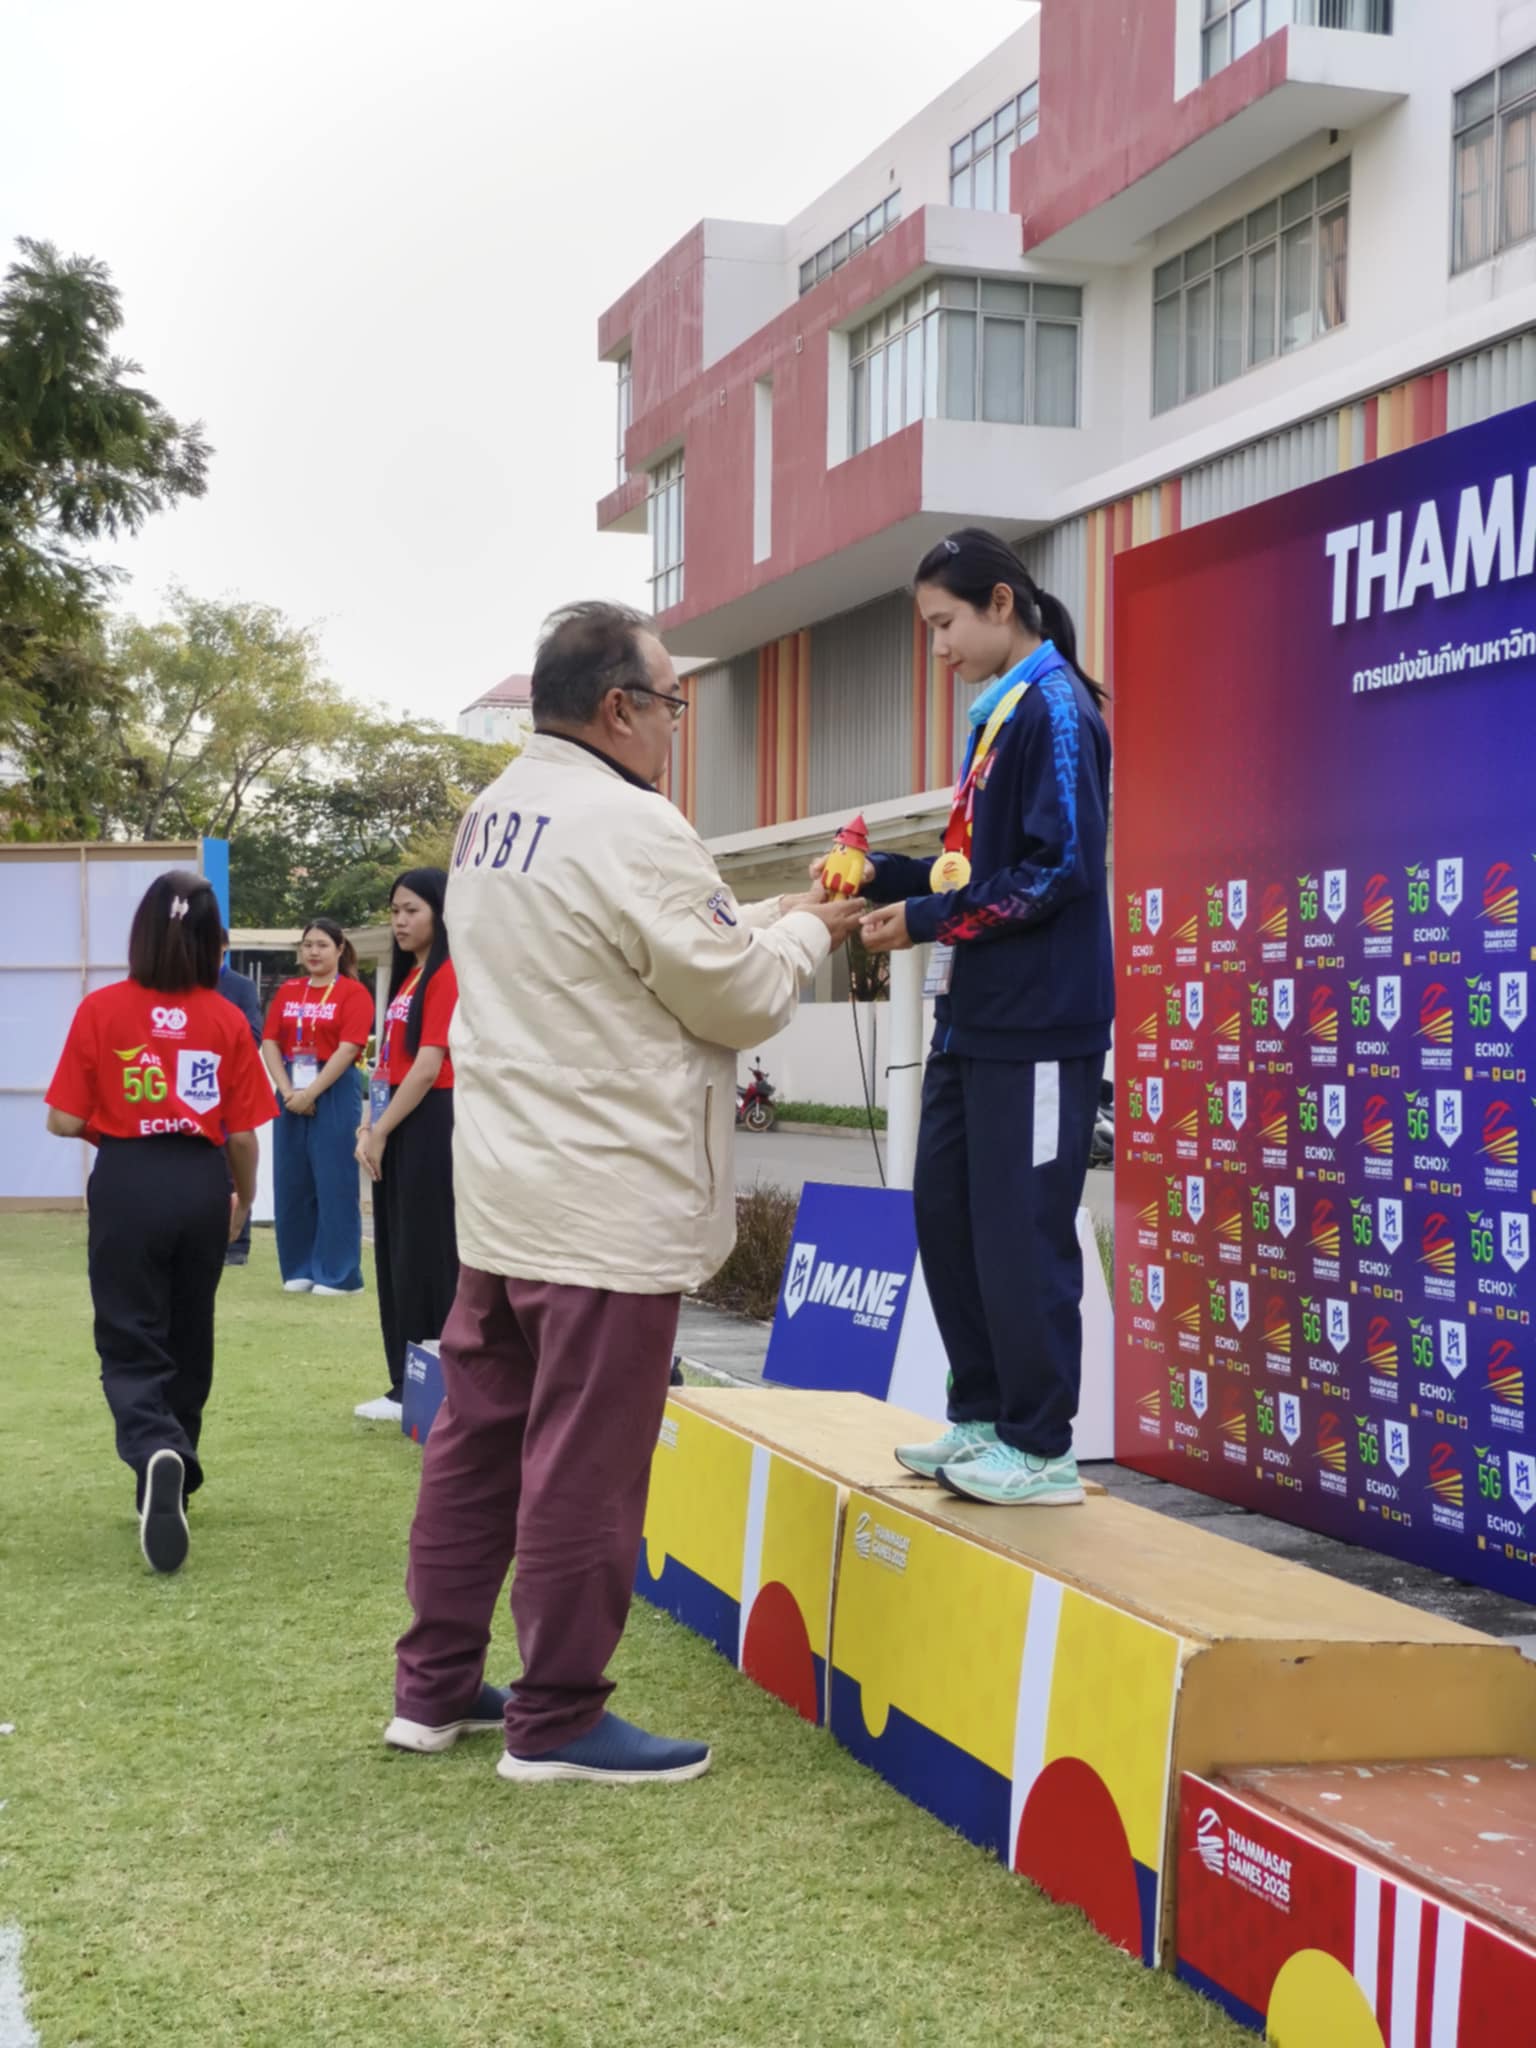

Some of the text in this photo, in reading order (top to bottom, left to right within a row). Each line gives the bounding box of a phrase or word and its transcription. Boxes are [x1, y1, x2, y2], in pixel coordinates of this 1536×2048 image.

[1300, 891, 1317, 920] 5G
[1408, 881, 1429, 913] 5G
[1478, 981, 1492, 992] AIS
[152, 1006, 188, 1030] 90
[1251, 998, 1267, 1026] 5G
[1351, 996, 1370, 1026] 5G
[1469, 994, 1491, 1026] 5G
[123, 1066, 168, 1102] 5G
[1299, 1103, 1317, 1131] 5G
[1408, 1109, 1429, 1139] 5G
[1253, 1202, 1269, 1230] 5G
[1352, 1214, 1372, 1245] 5G
[1480, 1218, 1493, 1228] AIS
[1471, 1229, 1493, 1263] 5G
[807, 1261, 907, 1318] IMANE
[1303, 1313, 1321, 1343] 5G
[1412, 1334, 1433, 1368] 5G
[1257, 1405, 1274, 1435] 5G
[1359, 1432, 1378, 1465] 5G
[1487, 1454, 1500, 1466] AIS
[1478, 1464, 1501, 1499] 5G
[1228, 1827, 1292, 1881] THAMMASAT
[1227, 1851, 1262, 1887] GAMES
[1263, 1871, 1290, 1903] 2025
